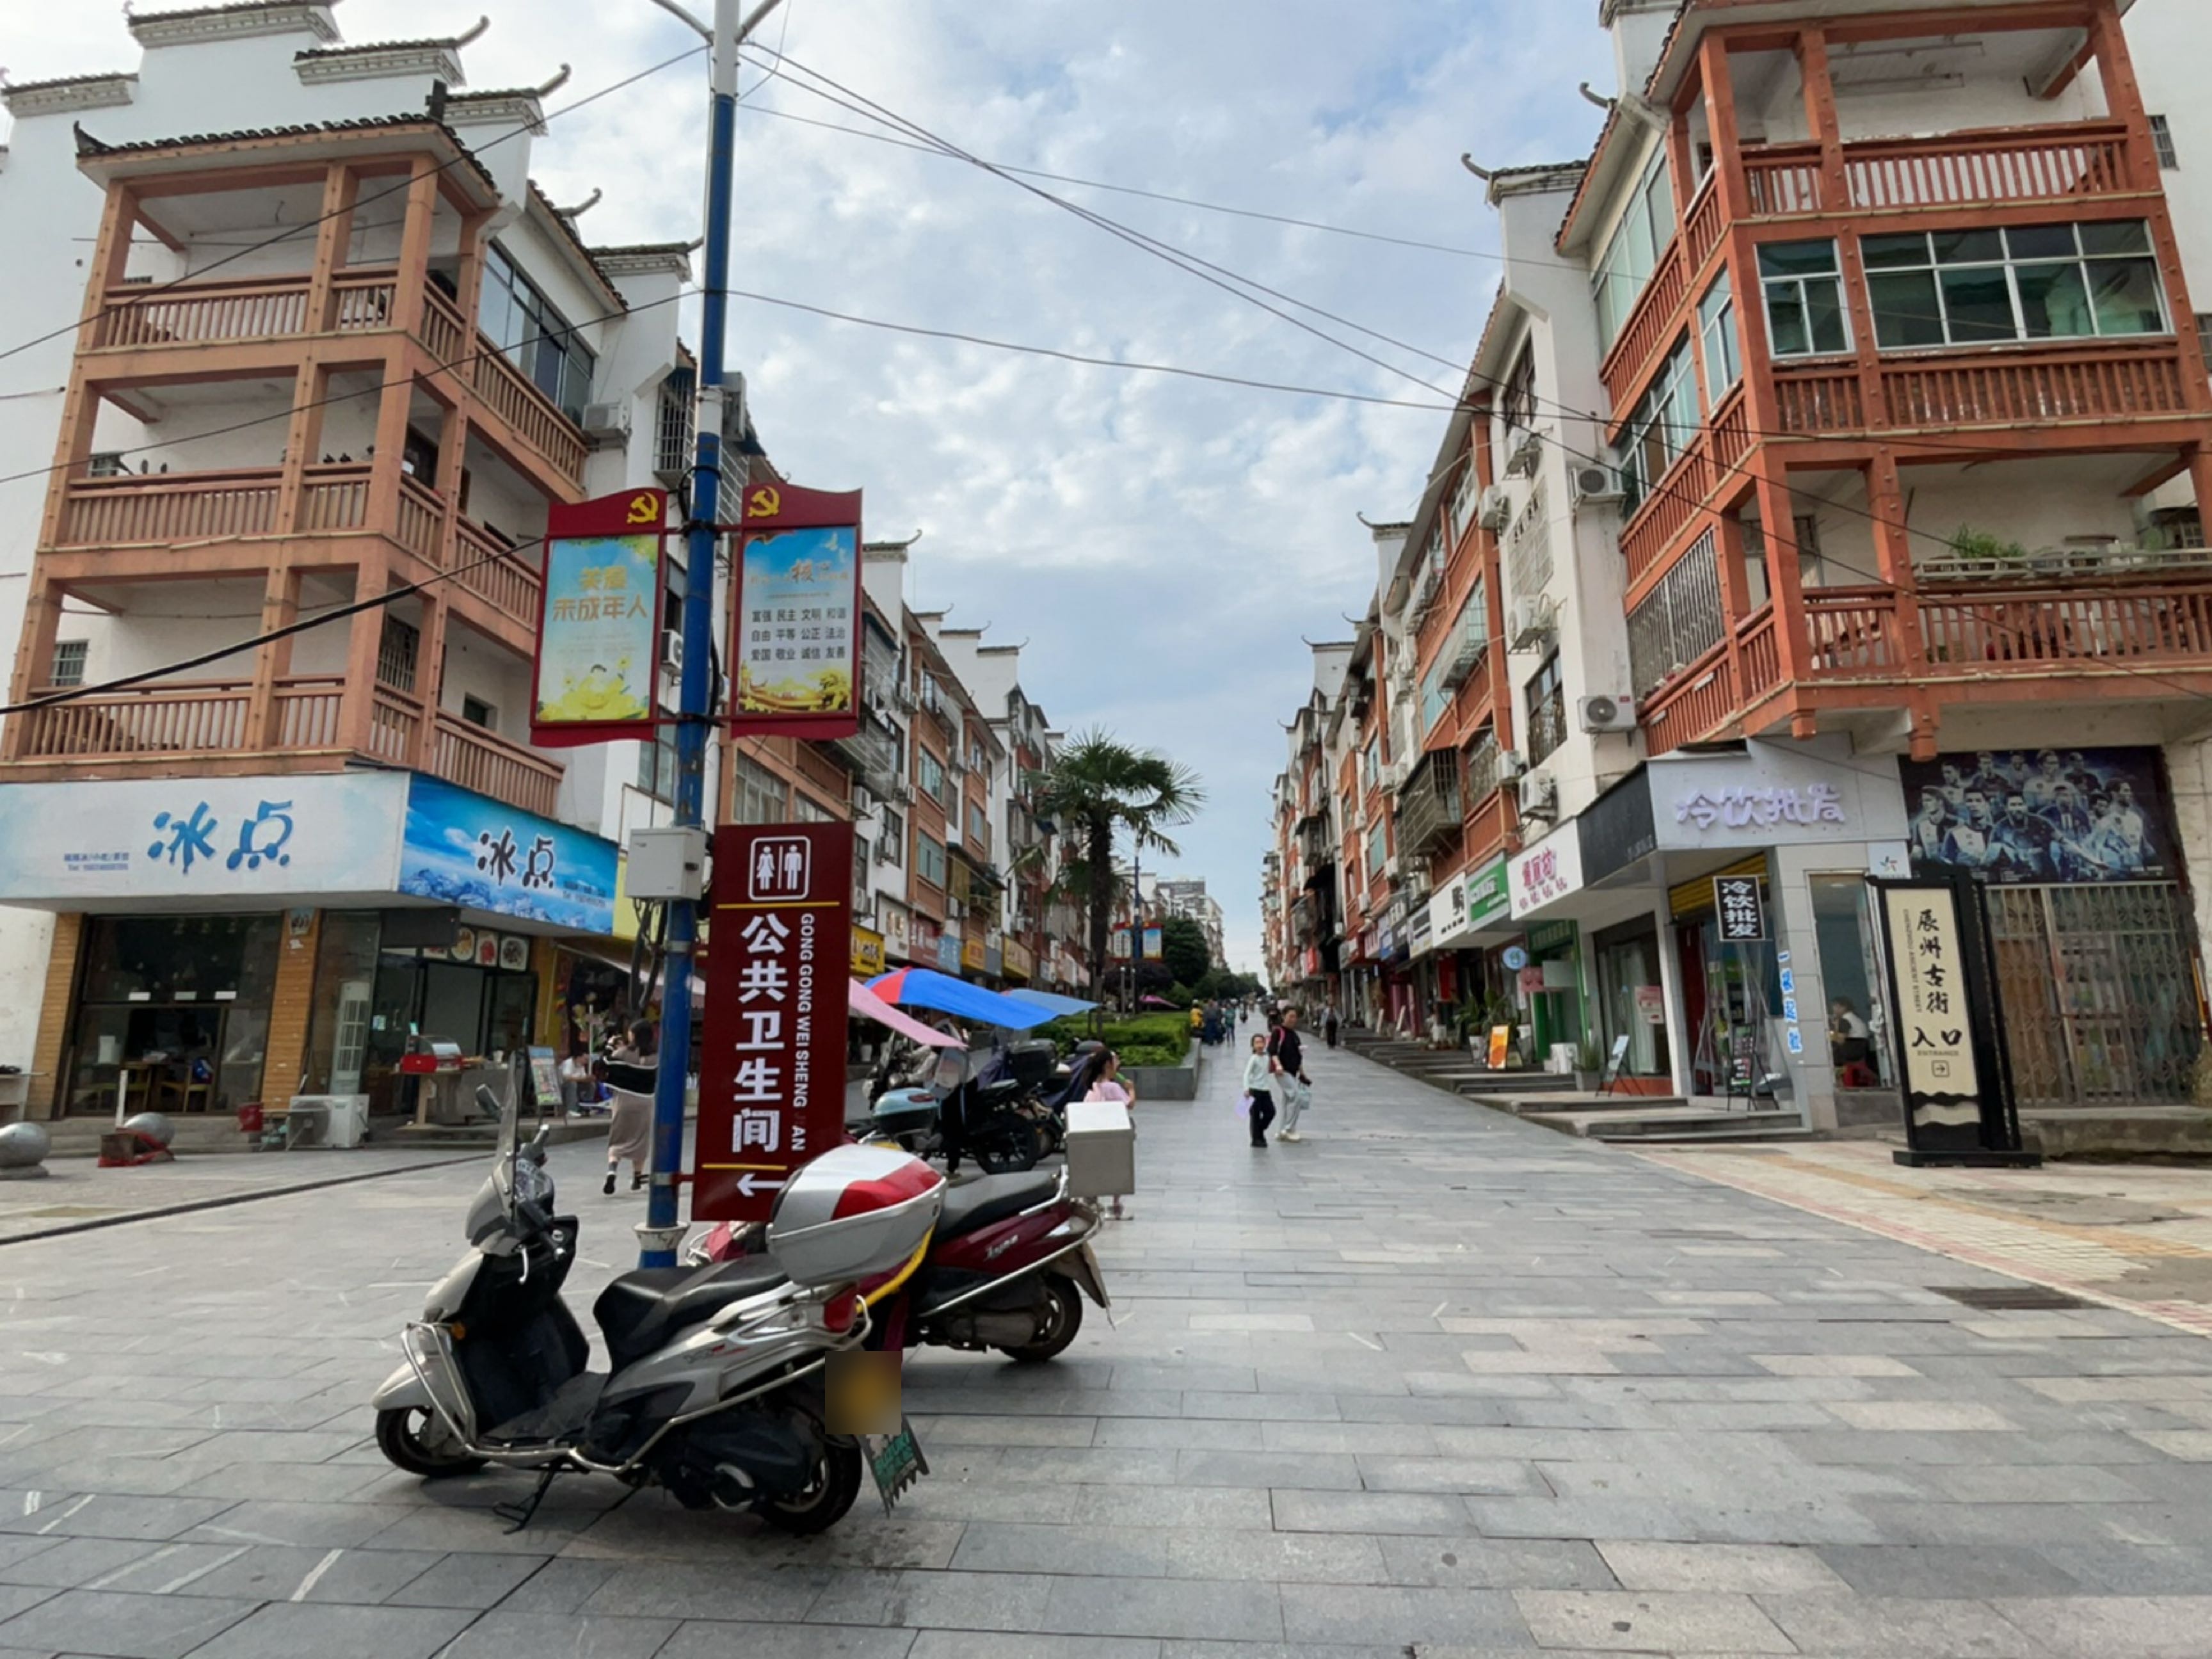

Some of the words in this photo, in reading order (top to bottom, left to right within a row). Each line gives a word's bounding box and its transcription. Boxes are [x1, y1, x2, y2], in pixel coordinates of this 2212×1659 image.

[553, 593, 648, 621] 未成年人
[777, 609, 797, 621] 民主
[801, 608, 821, 621] 文明
[751, 629, 771, 642] 自由
[776, 629, 796, 641] 平等
[801, 627, 821, 640] 公正
[801, 647, 821, 660] 诚信
[1676, 783, 1845, 830] 冷饮批发
[147, 800, 293, 875] 冰点
[477, 830, 554, 888] 冰点
[1722, 880, 1758, 938] 冷饮批发
[799, 913, 815, 961] GONG
[1917, 909, 1949, 1014] 辰州古街
[797, 964, 813, 1014] GONG
[732, 913, 790, 1153] 公共卫生间
[796, 1016, 811, 1048] WEI
[1912, 1026, 1962, 1048] 入口
[793, 1050, 810, 1108] SHENG
